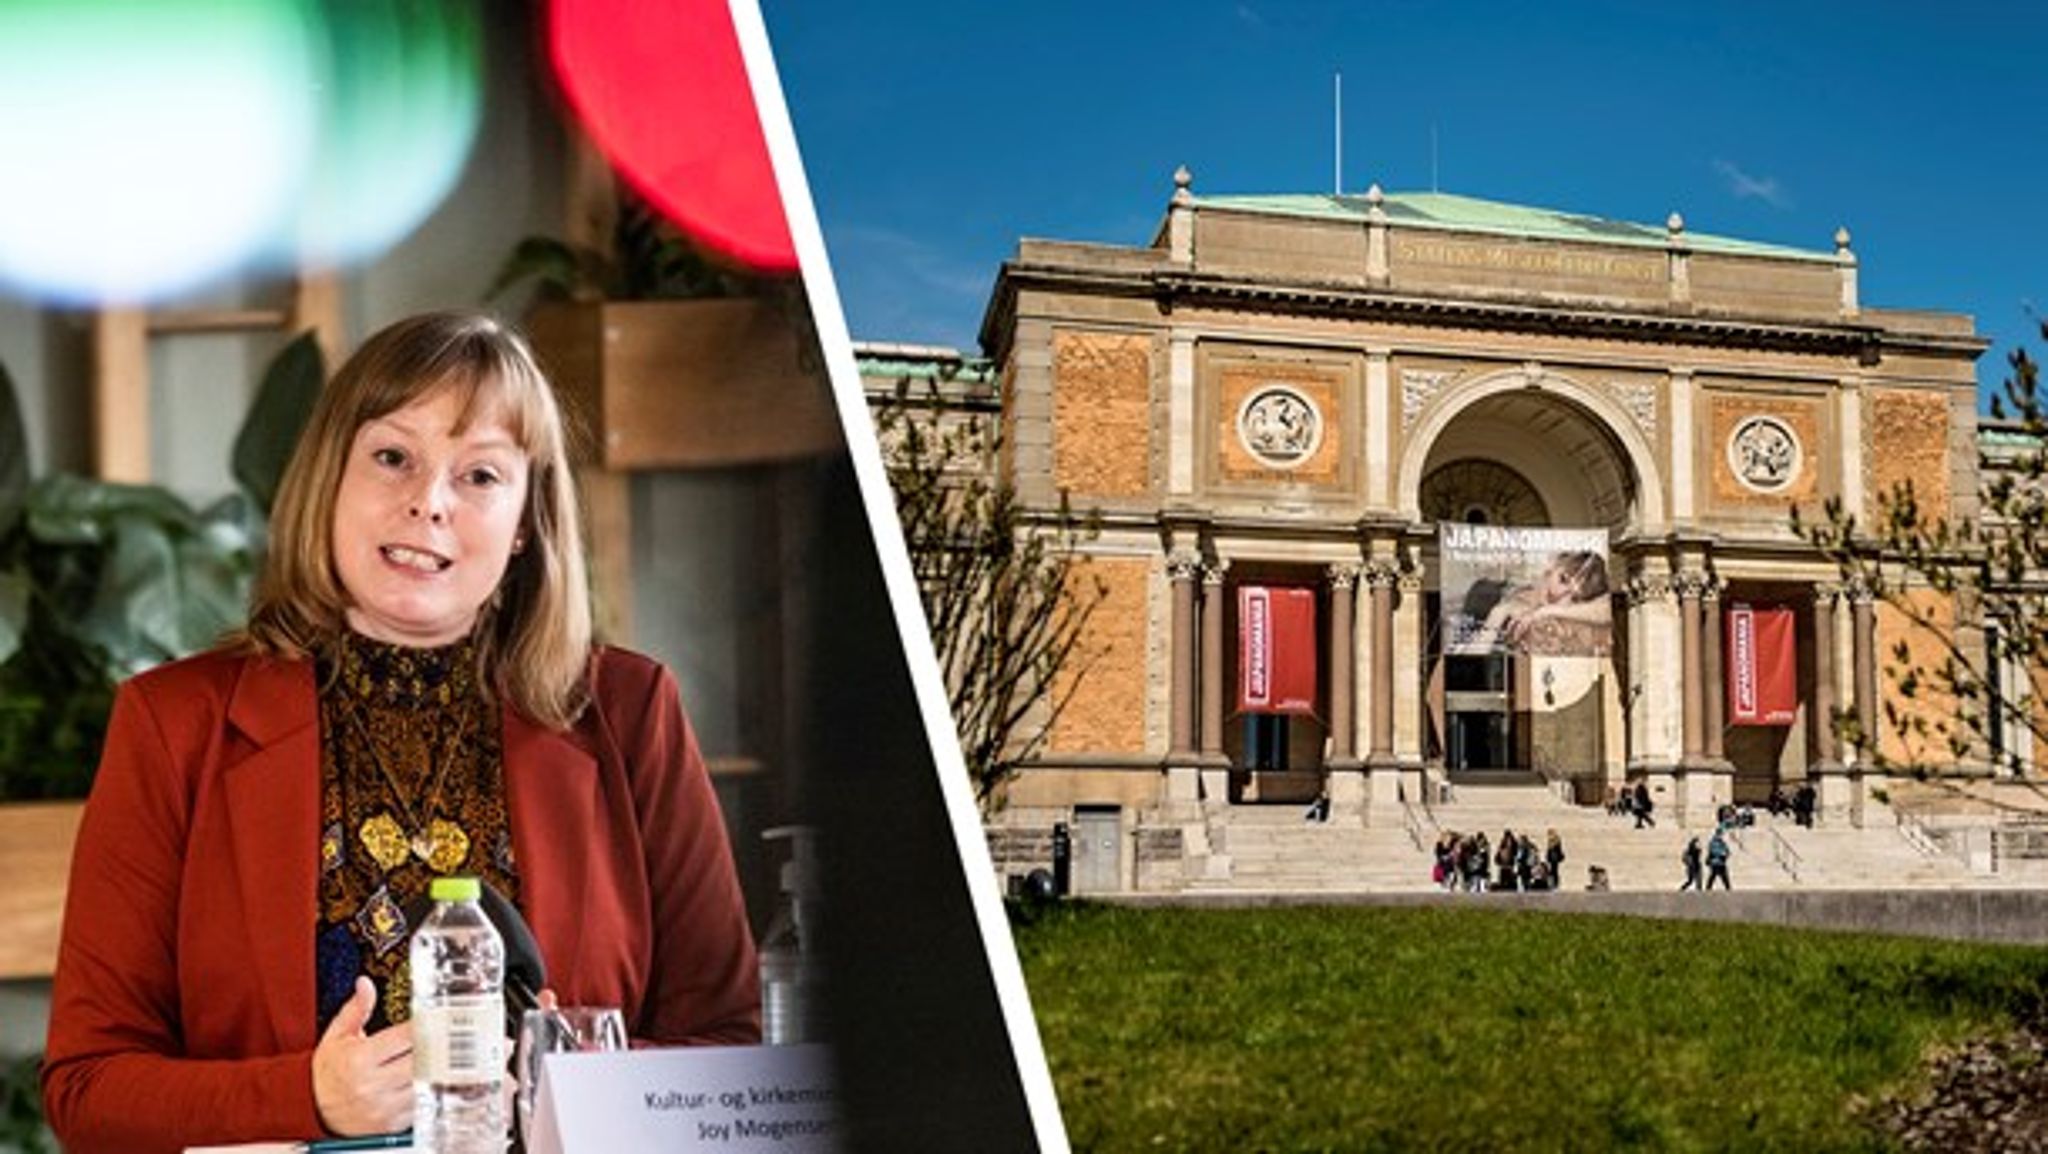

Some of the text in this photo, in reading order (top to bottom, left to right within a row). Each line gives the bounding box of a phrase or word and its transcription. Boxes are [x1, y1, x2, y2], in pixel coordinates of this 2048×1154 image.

[644, 1090, 713, 1110] Kultur-
[718, 1092, 747, 1111] og
[697, 1121, 730, 1141] Joy
